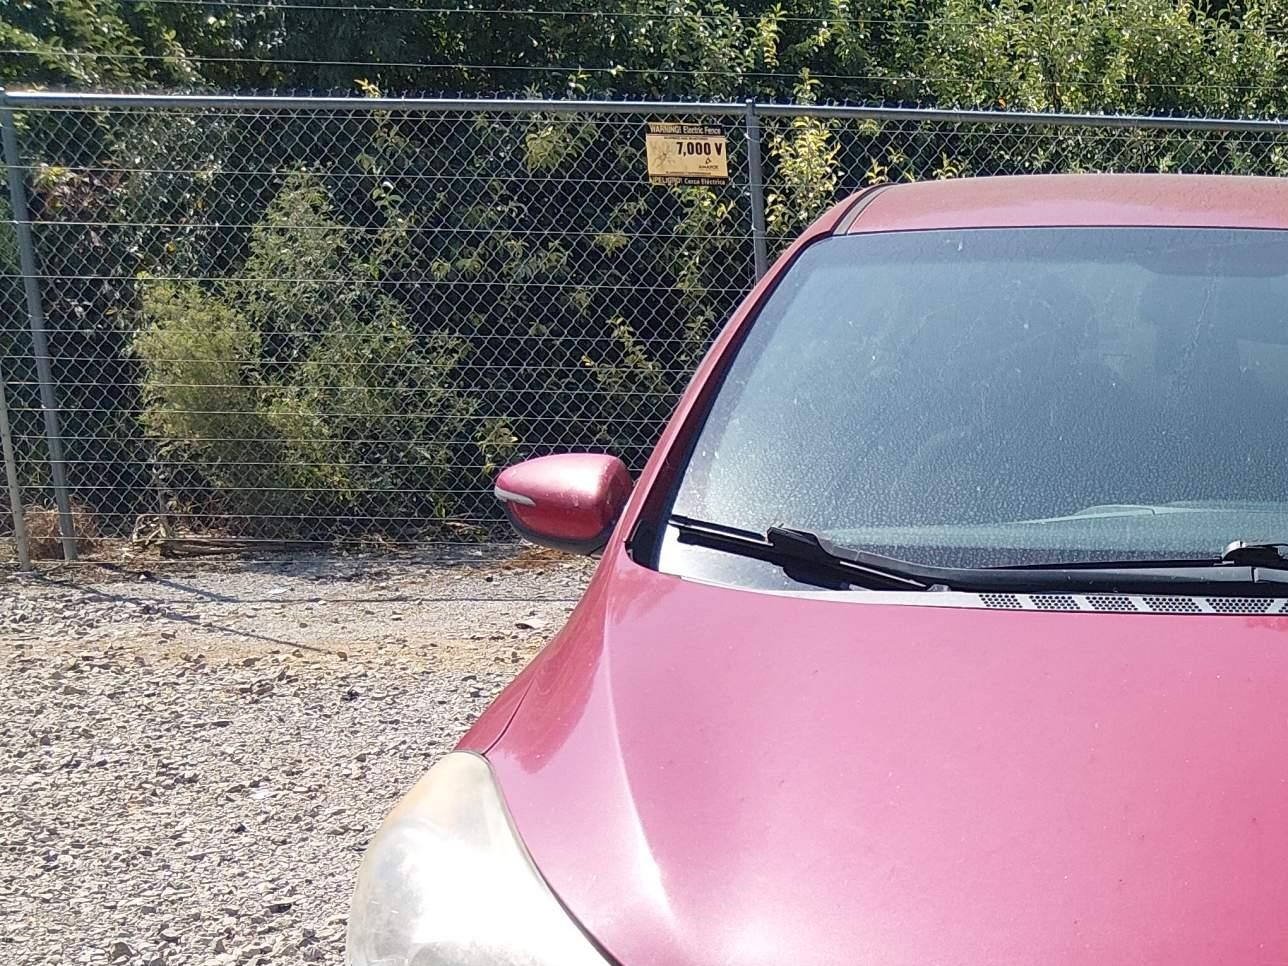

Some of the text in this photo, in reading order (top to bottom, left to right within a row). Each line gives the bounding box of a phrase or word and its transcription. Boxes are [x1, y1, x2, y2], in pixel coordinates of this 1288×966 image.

[683, 126, 704, 135] Electric
[676, 142, 723, 157] 7,000 V
